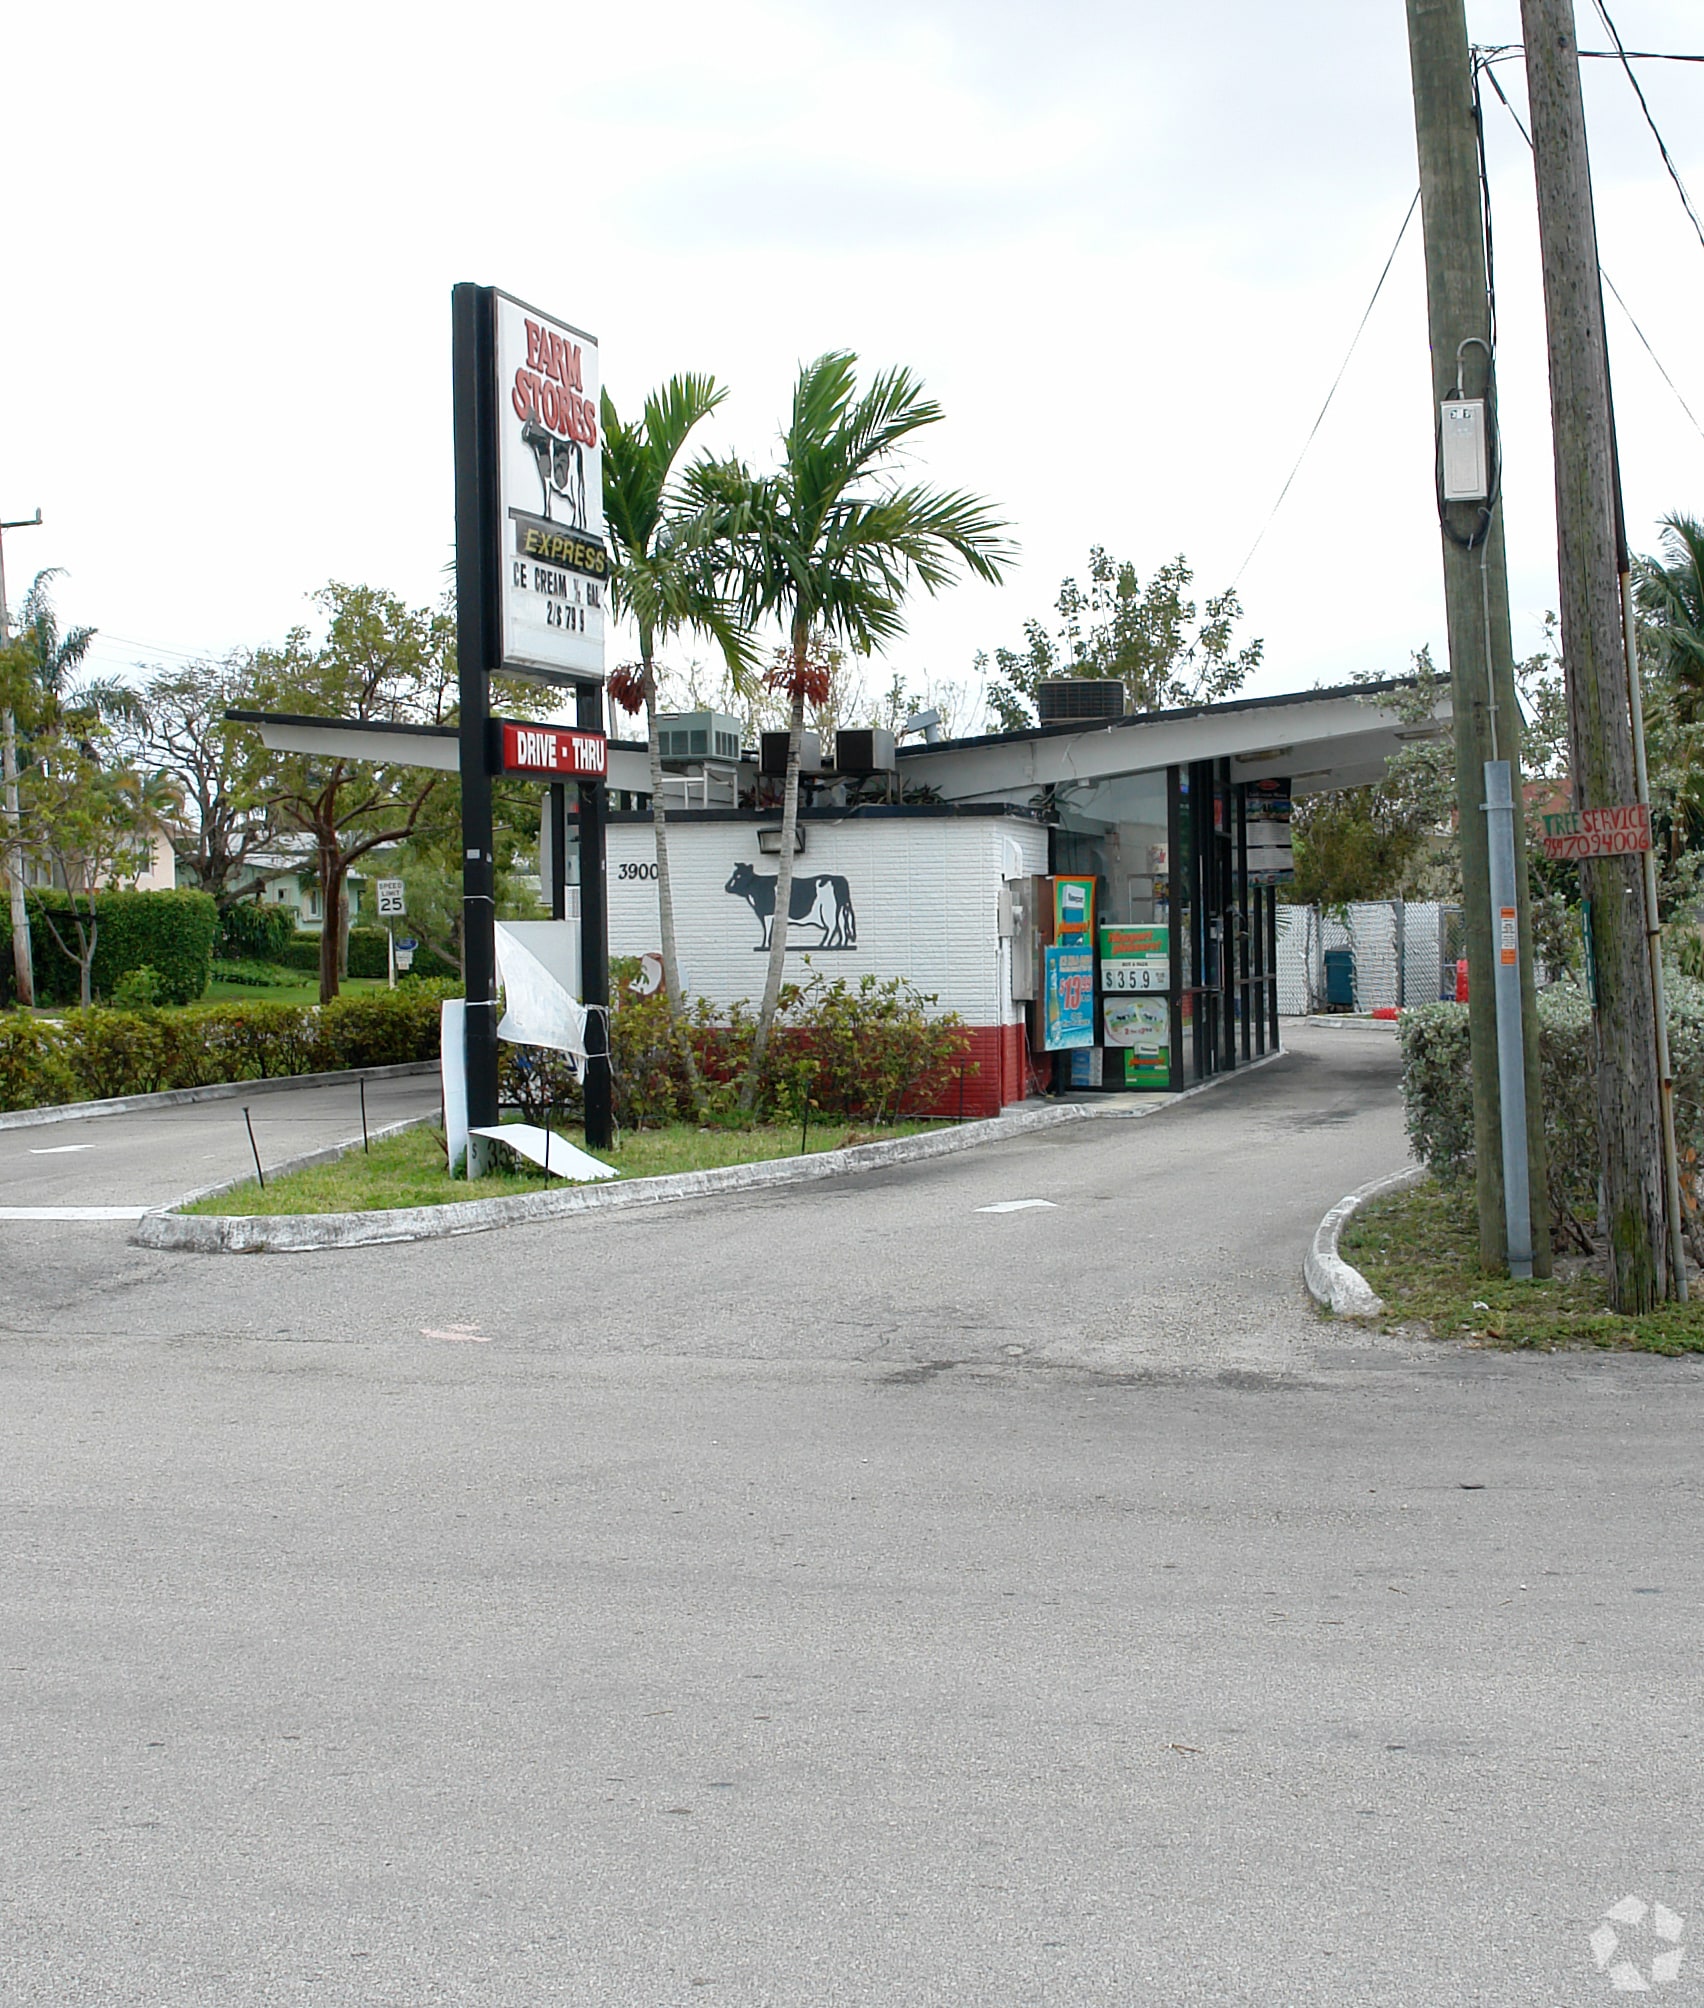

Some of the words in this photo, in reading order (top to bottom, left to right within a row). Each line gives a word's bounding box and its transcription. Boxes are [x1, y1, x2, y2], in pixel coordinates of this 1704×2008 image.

[524, 317, 583, 393] FARM
[512, 367, 597, 449] STORES
[525, 528, 605, 573] EXPRESS
[513, 561, 527, 589] CE
[534, 567, 567, 599] CREAM
[517, 731, 557, 768] DRIVE
[572, 737, 605, 772] THRU
[1542, 812, 1581, 837] TREE
[1582, 805, 1649, 833] SERVICE
[618, 863, 659, 880] 3900
[380, 897, 402, 911] 25
